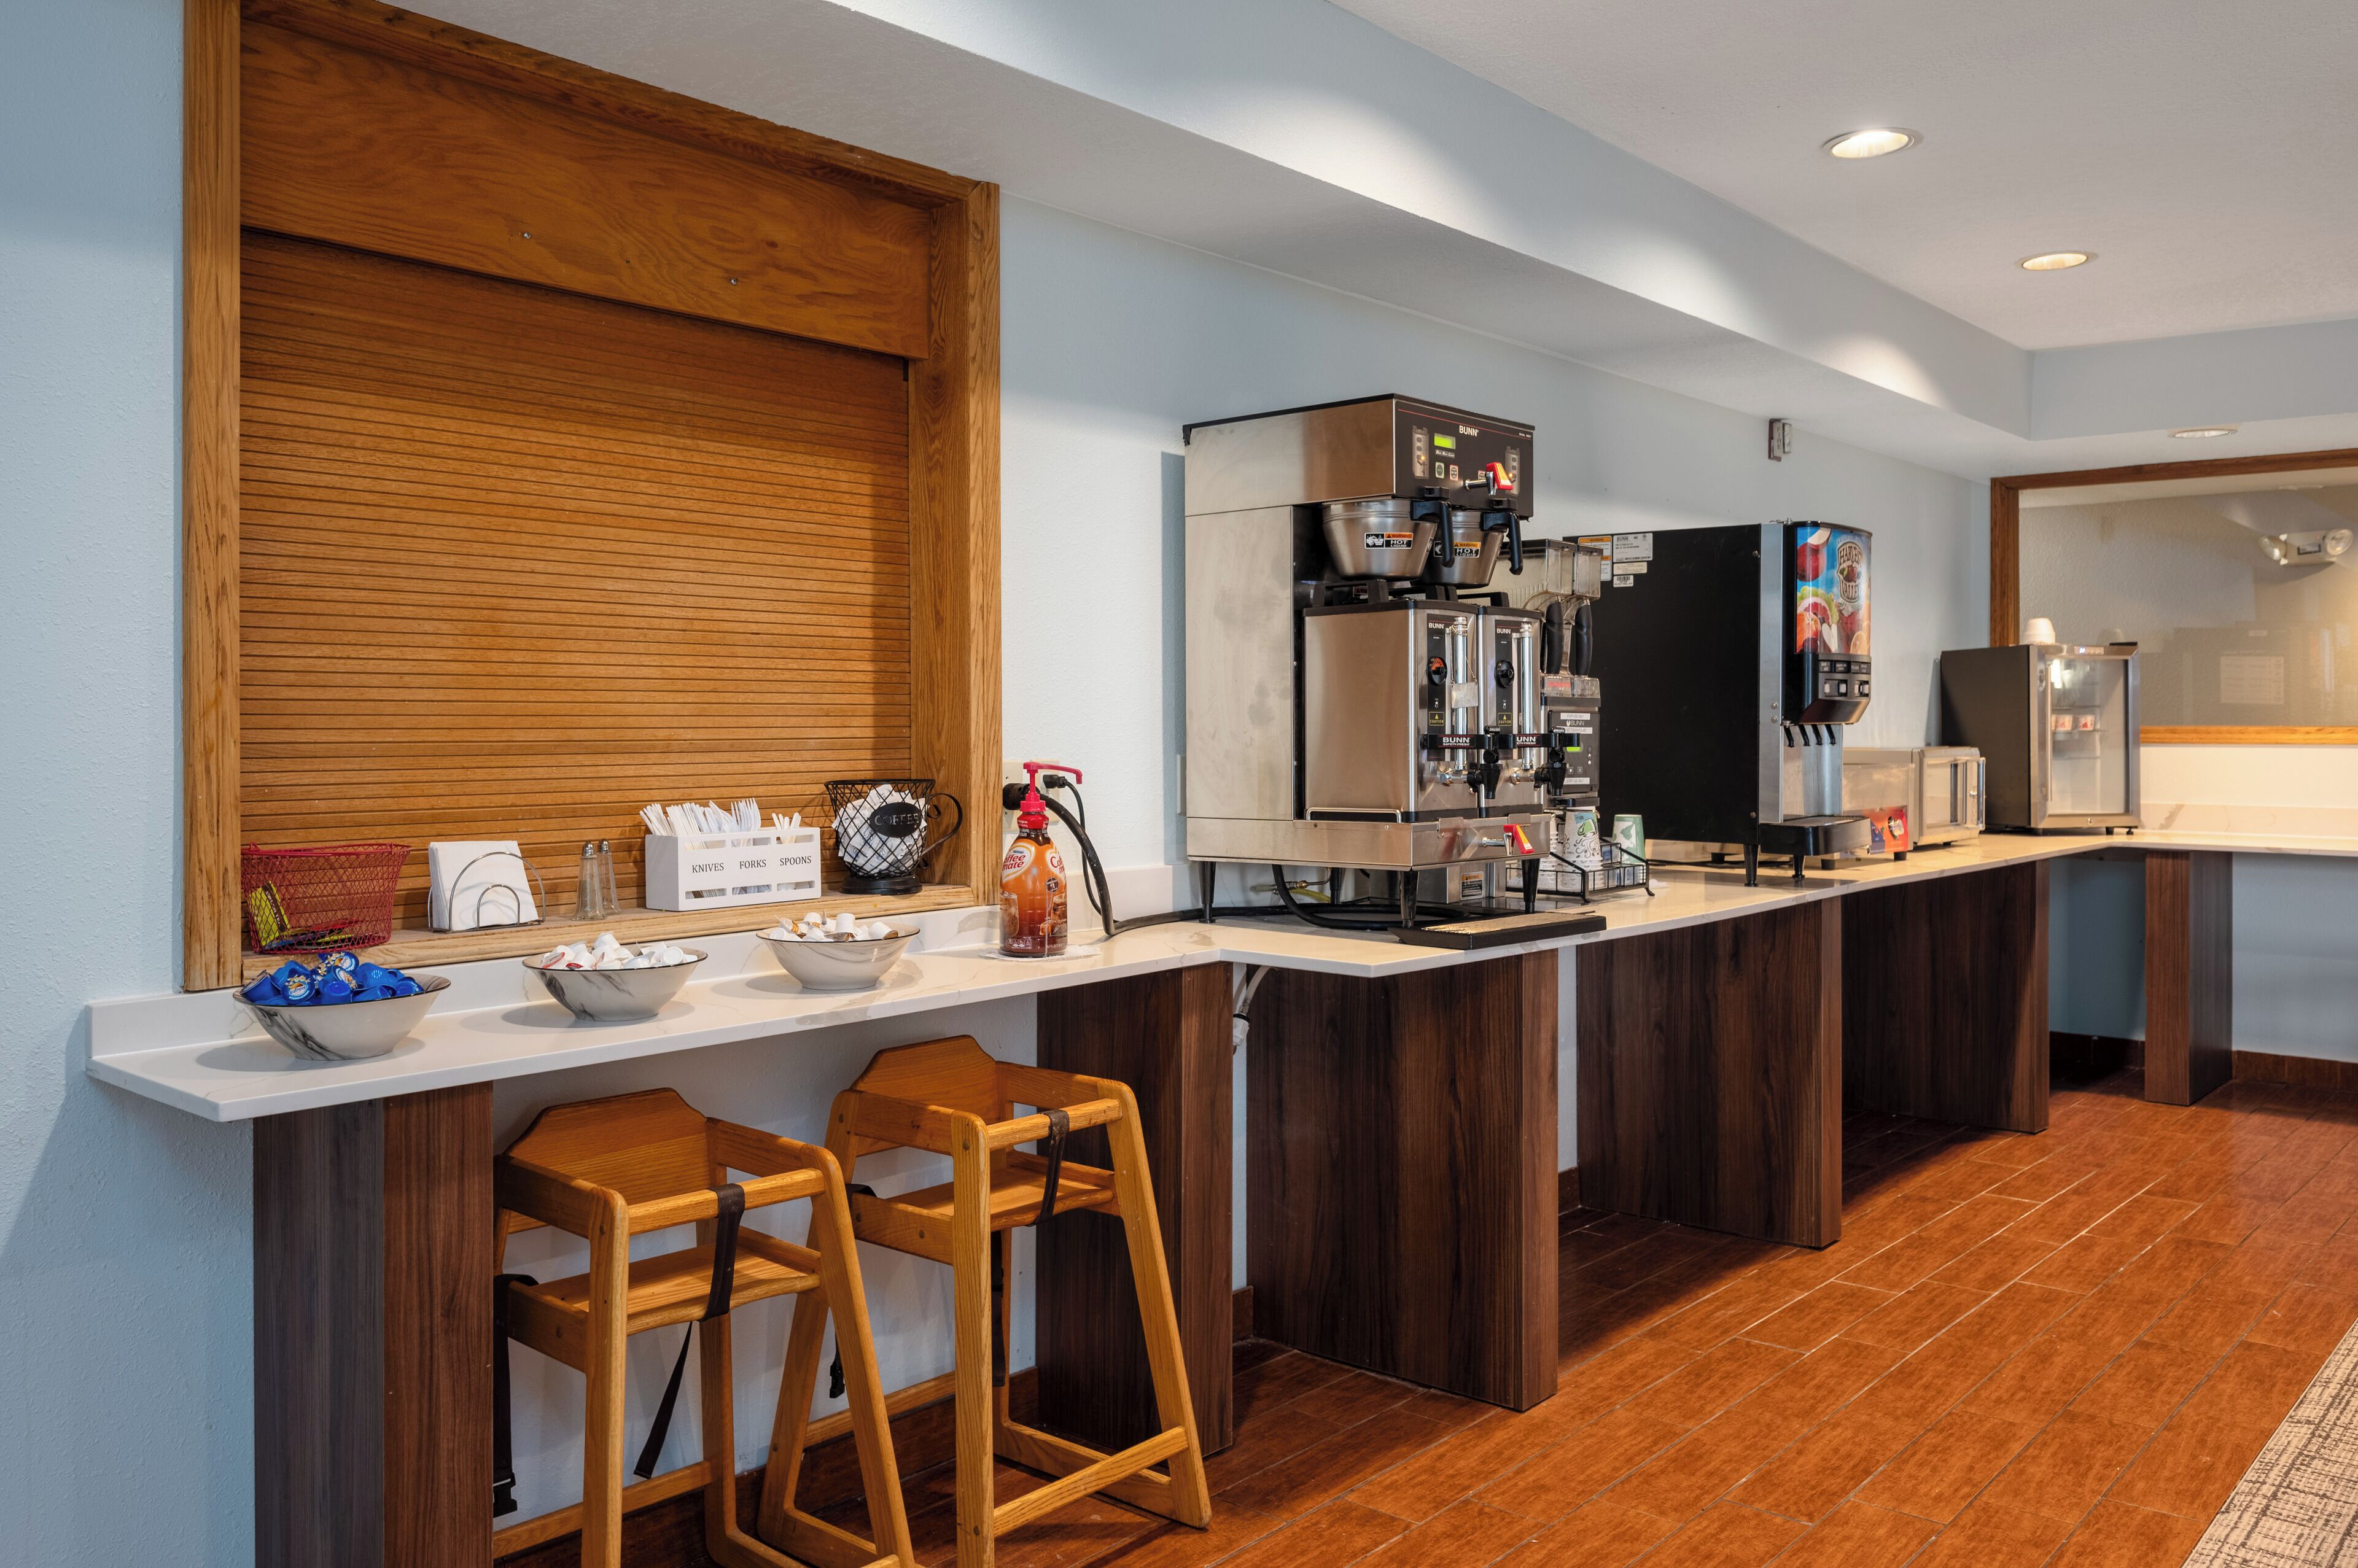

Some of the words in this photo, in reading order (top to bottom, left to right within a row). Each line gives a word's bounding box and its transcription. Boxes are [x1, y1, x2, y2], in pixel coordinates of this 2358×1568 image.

[1459, 425, 1477, 437] BUNN
[1840, 546, 1862, 565] HARVEST
[1842, 580, 1860, 600] VALLEY
[874, 813, 919, 826] COFFEE
[739, 859, 767, 869] FORKS
[780, 855, 812, 866] SPOONS
[1003, 854, 1025, 864] offee
[692, 863, 724, 873] KNIVES
[1002, 861, 1024, 871] mate
